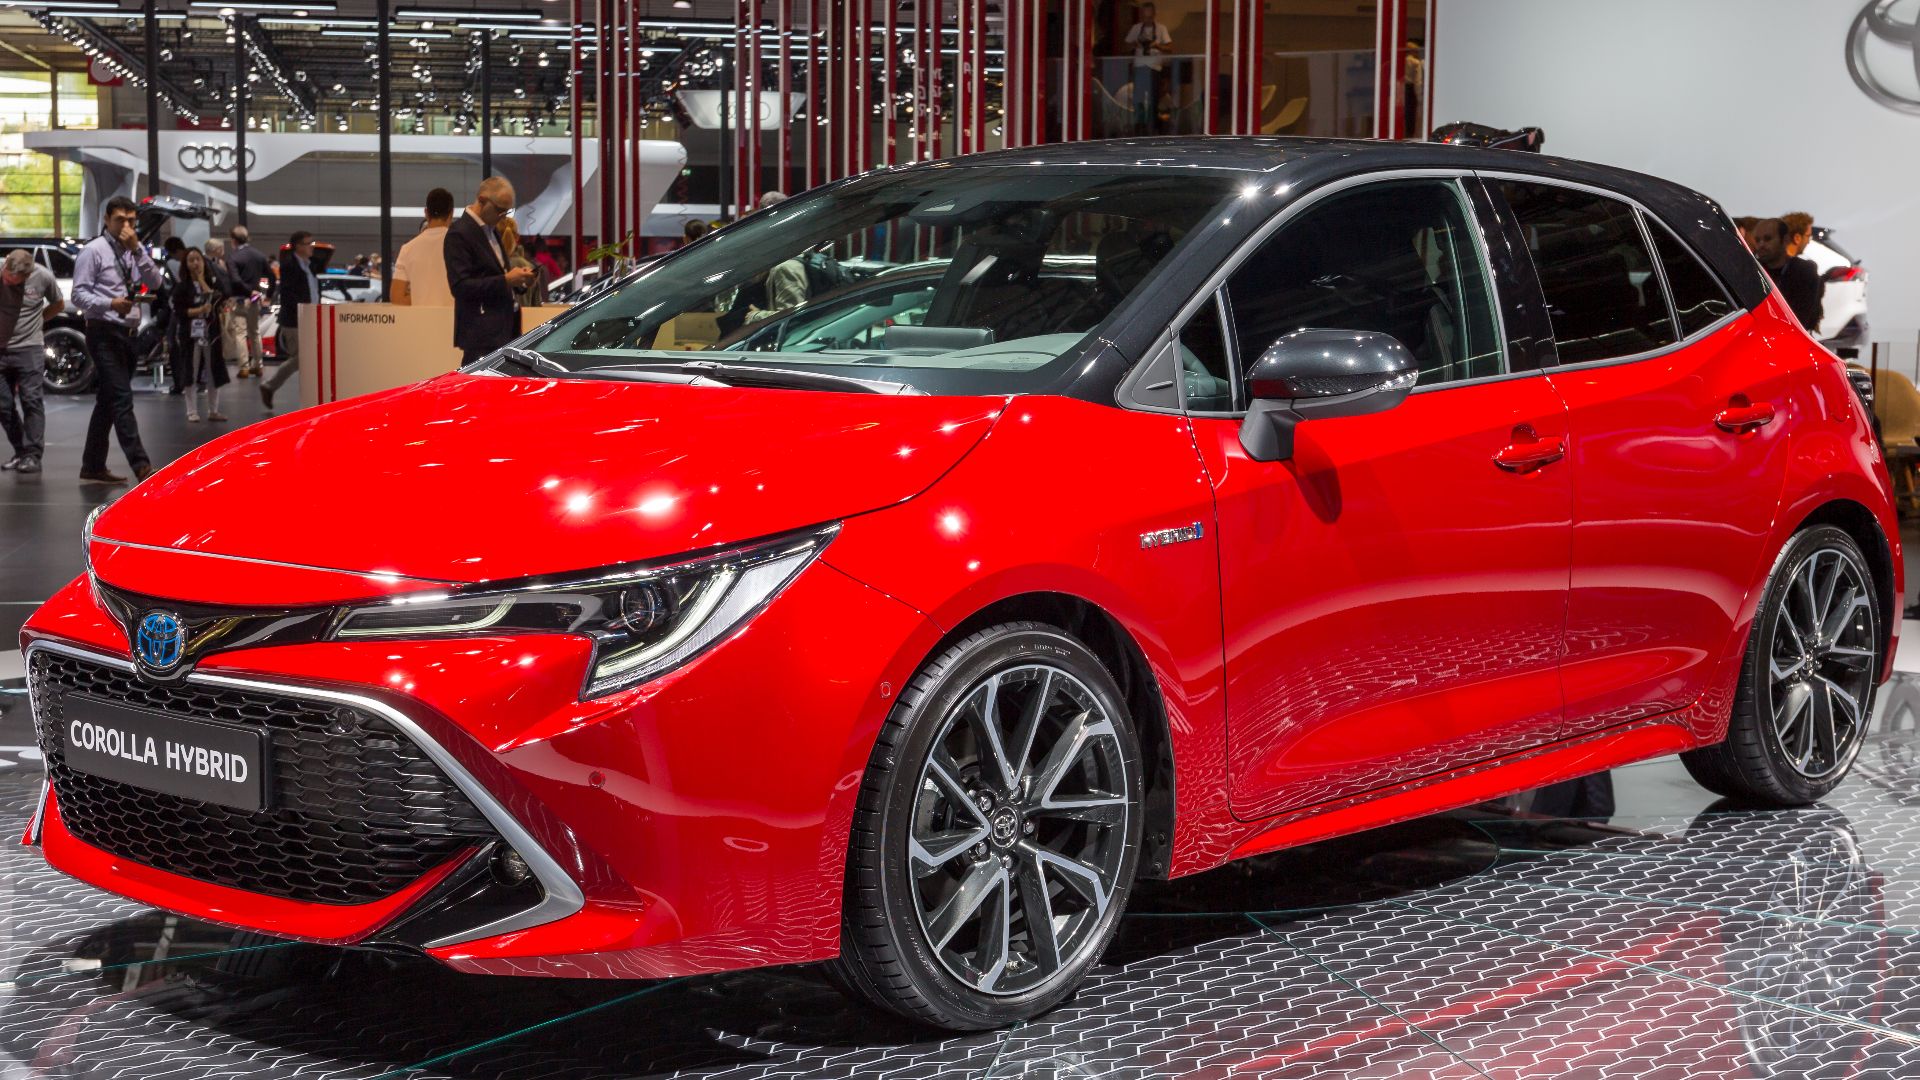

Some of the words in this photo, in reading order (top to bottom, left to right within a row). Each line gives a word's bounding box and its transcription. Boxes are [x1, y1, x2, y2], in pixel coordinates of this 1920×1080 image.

[339, 313, 395, 324] INFORMATION
[1139, 525, 1197, 549] HYBRID
[70, 719, 158, 766] COROLLA
[165, 740, 248, 783] HYBRID
